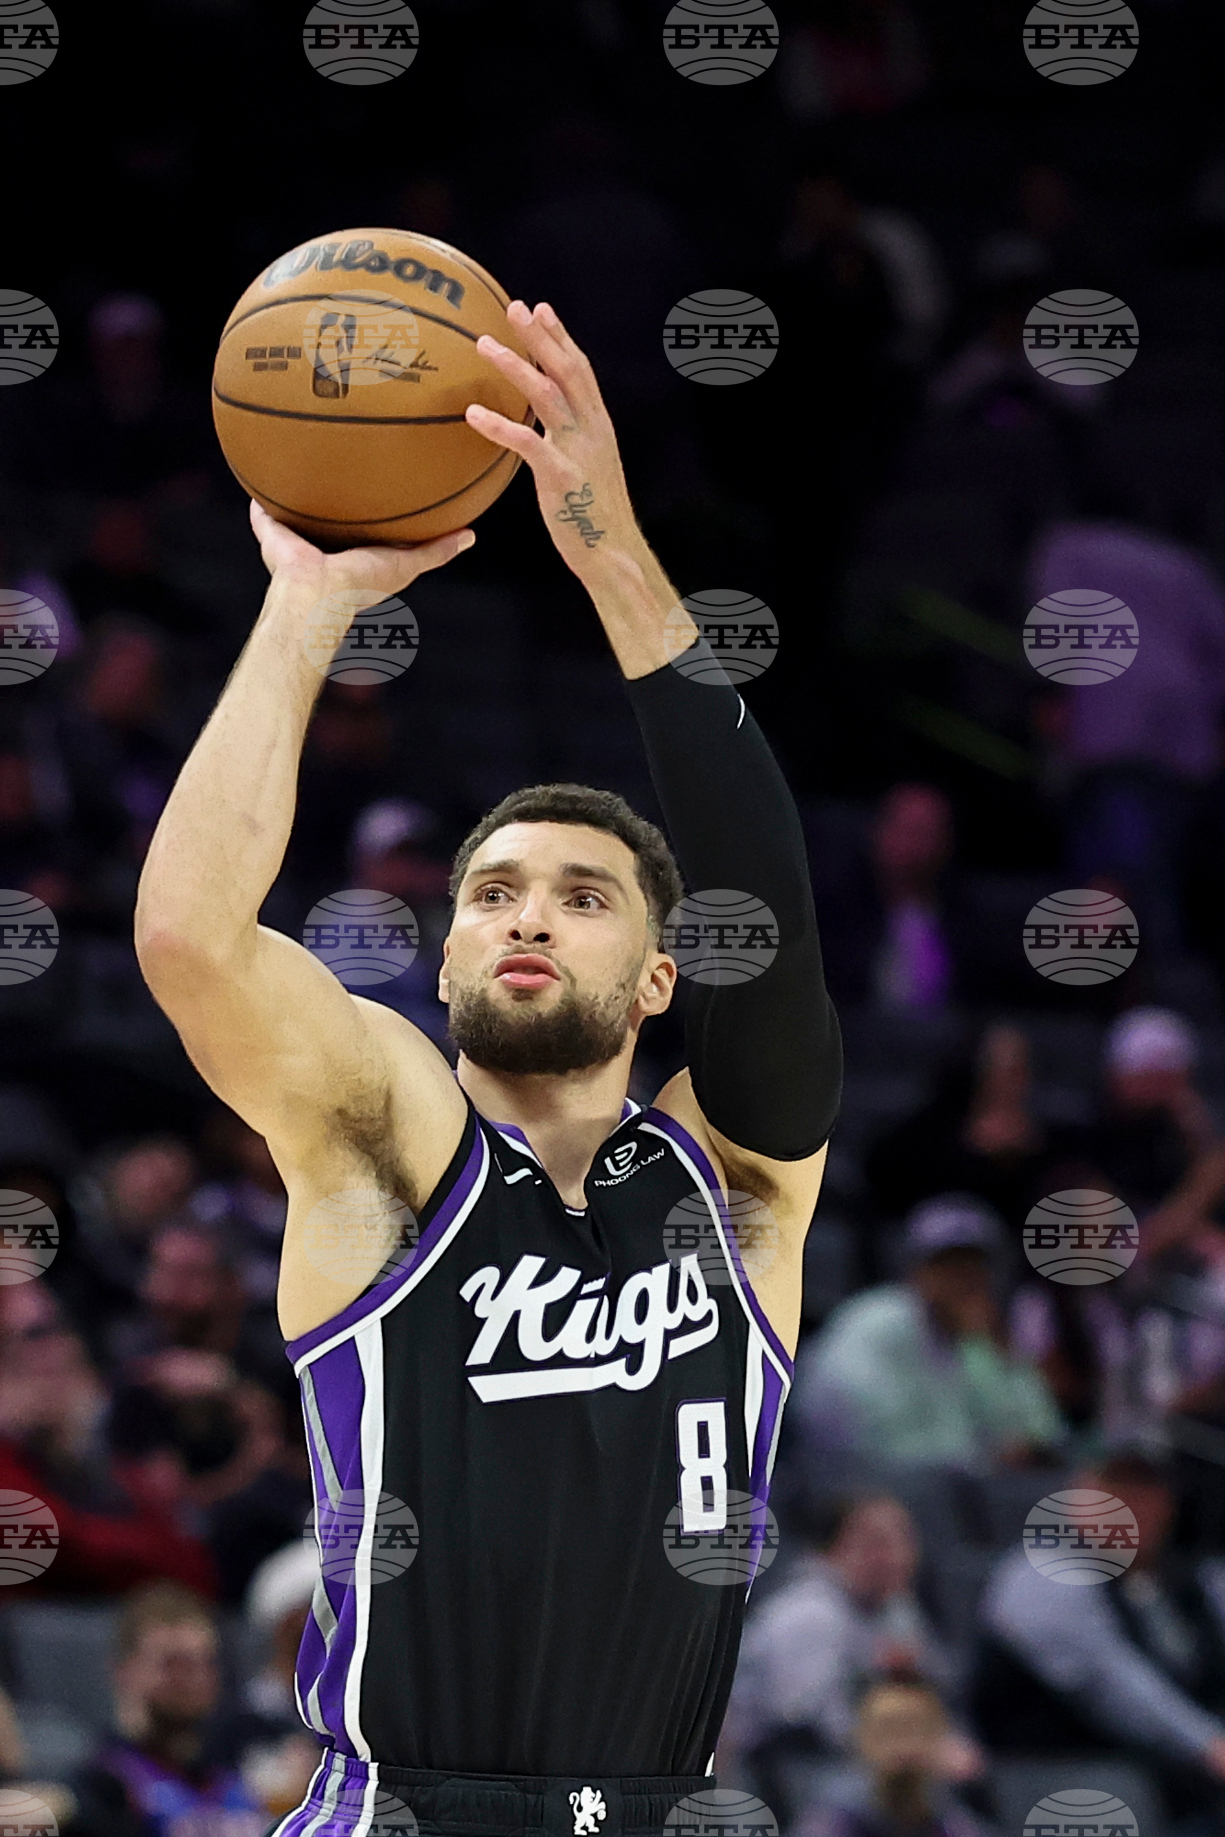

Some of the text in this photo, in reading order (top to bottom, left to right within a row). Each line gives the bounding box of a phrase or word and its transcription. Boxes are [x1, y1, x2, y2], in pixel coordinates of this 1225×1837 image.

[263, 240, 465, 310] Wilson
[594, 1148, 665, 1187] PHOONG LAW
[677, 1399, 728, 1534] 8
